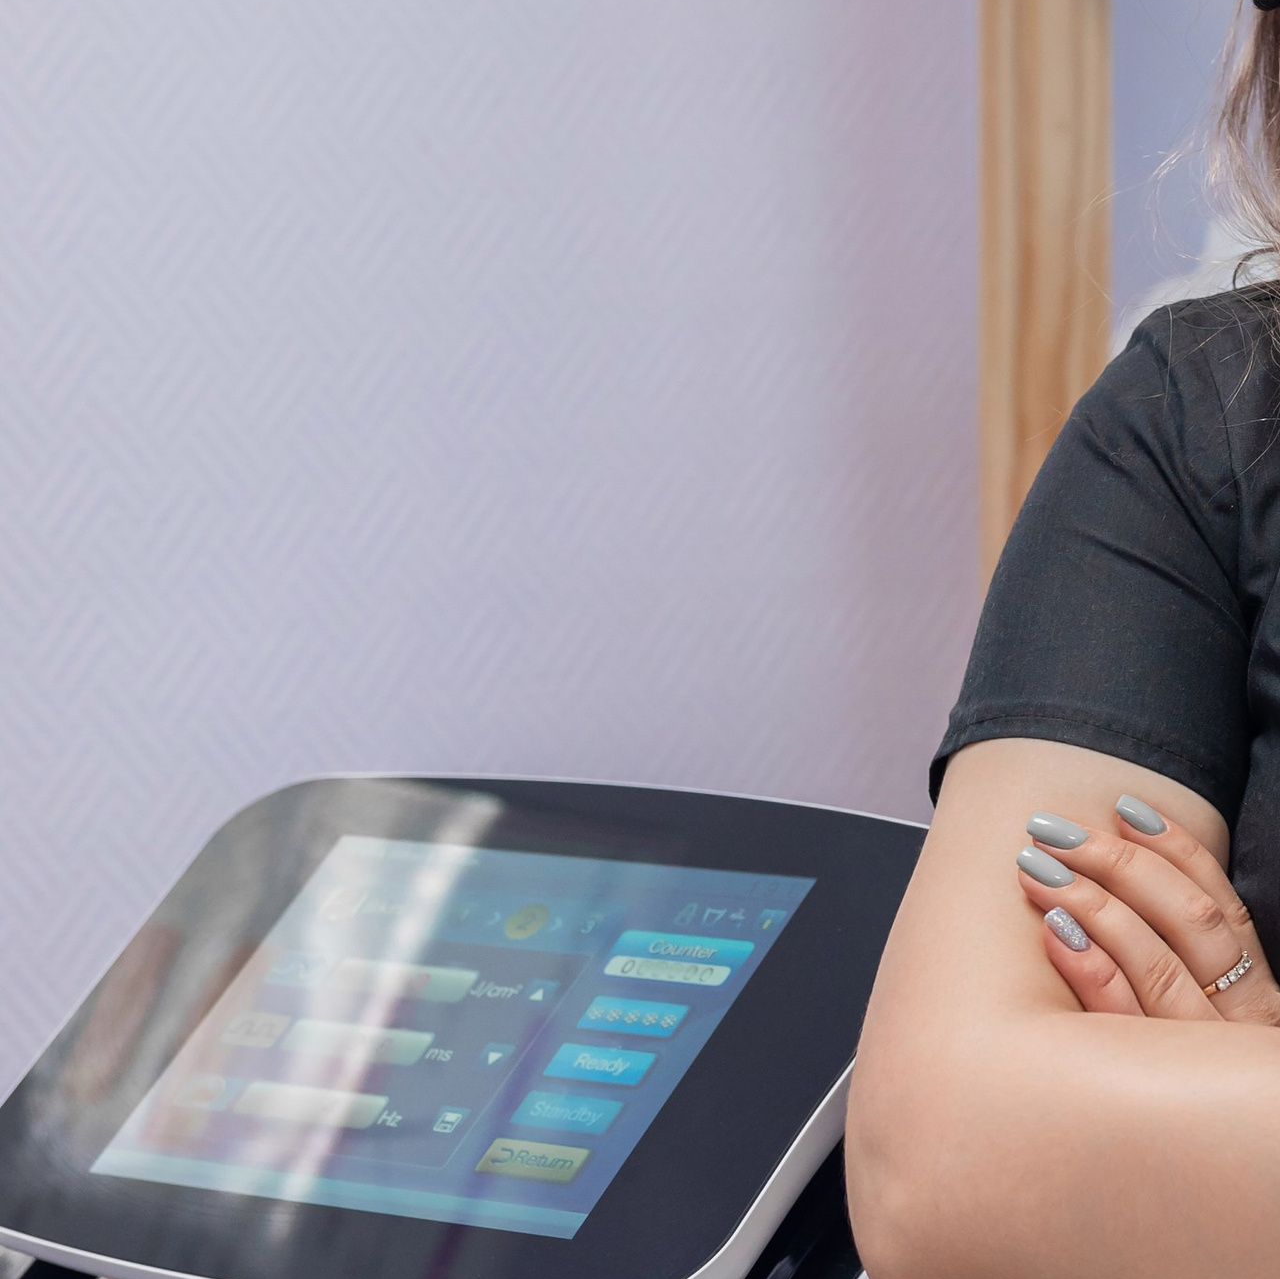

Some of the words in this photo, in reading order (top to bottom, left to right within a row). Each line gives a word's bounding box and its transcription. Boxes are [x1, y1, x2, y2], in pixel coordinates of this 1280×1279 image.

[648, 939, 719, 960] Counter
[424, 1048, 454, 1062] ms
[572, 1051, 631, 1077] Ready
[376, 1109, 403, 1128] Hz
[529, 1100, 605, 1127] Standby
[514, 1148, 574, 1171] Return
